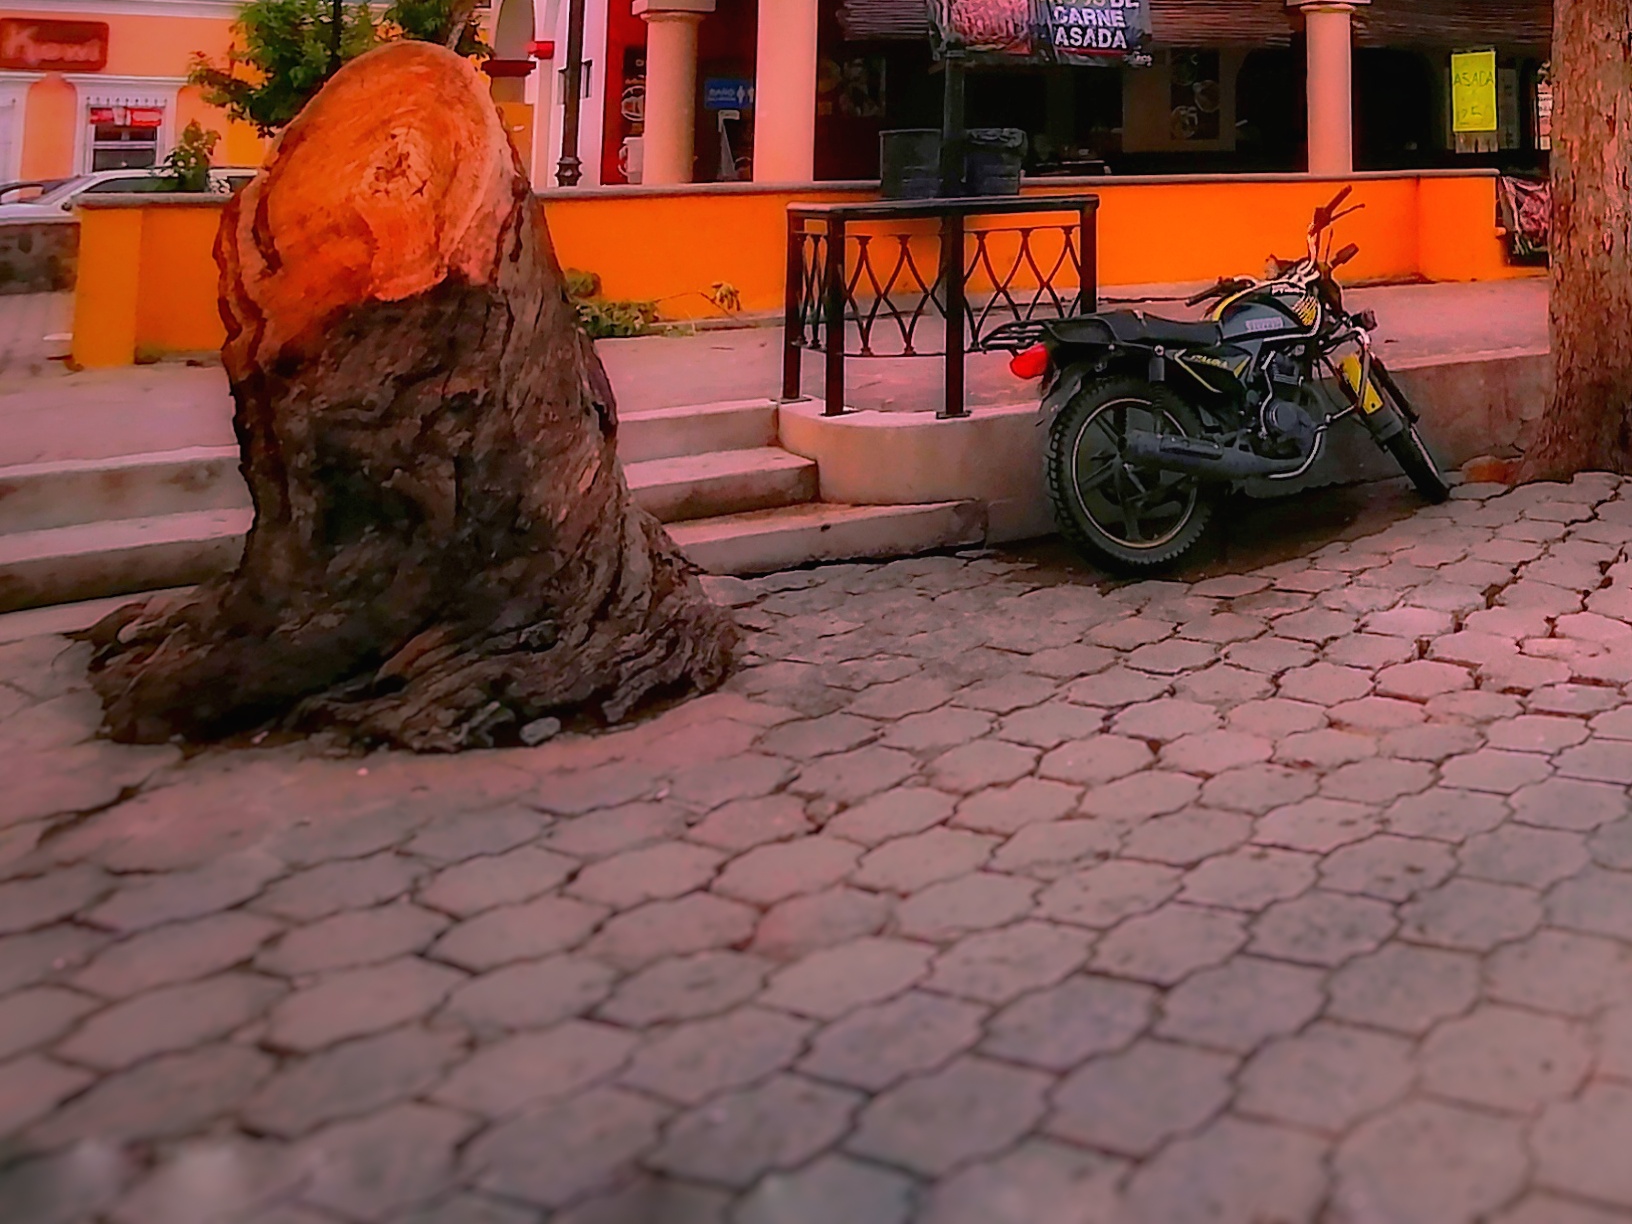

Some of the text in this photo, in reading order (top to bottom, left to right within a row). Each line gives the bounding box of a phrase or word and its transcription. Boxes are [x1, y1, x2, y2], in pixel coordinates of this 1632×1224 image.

[1054, 5, 1126, 27] CARNE
[1054, 26, 1128, 49] ASADA
[1453, 70, 1494, 87] ASADA
